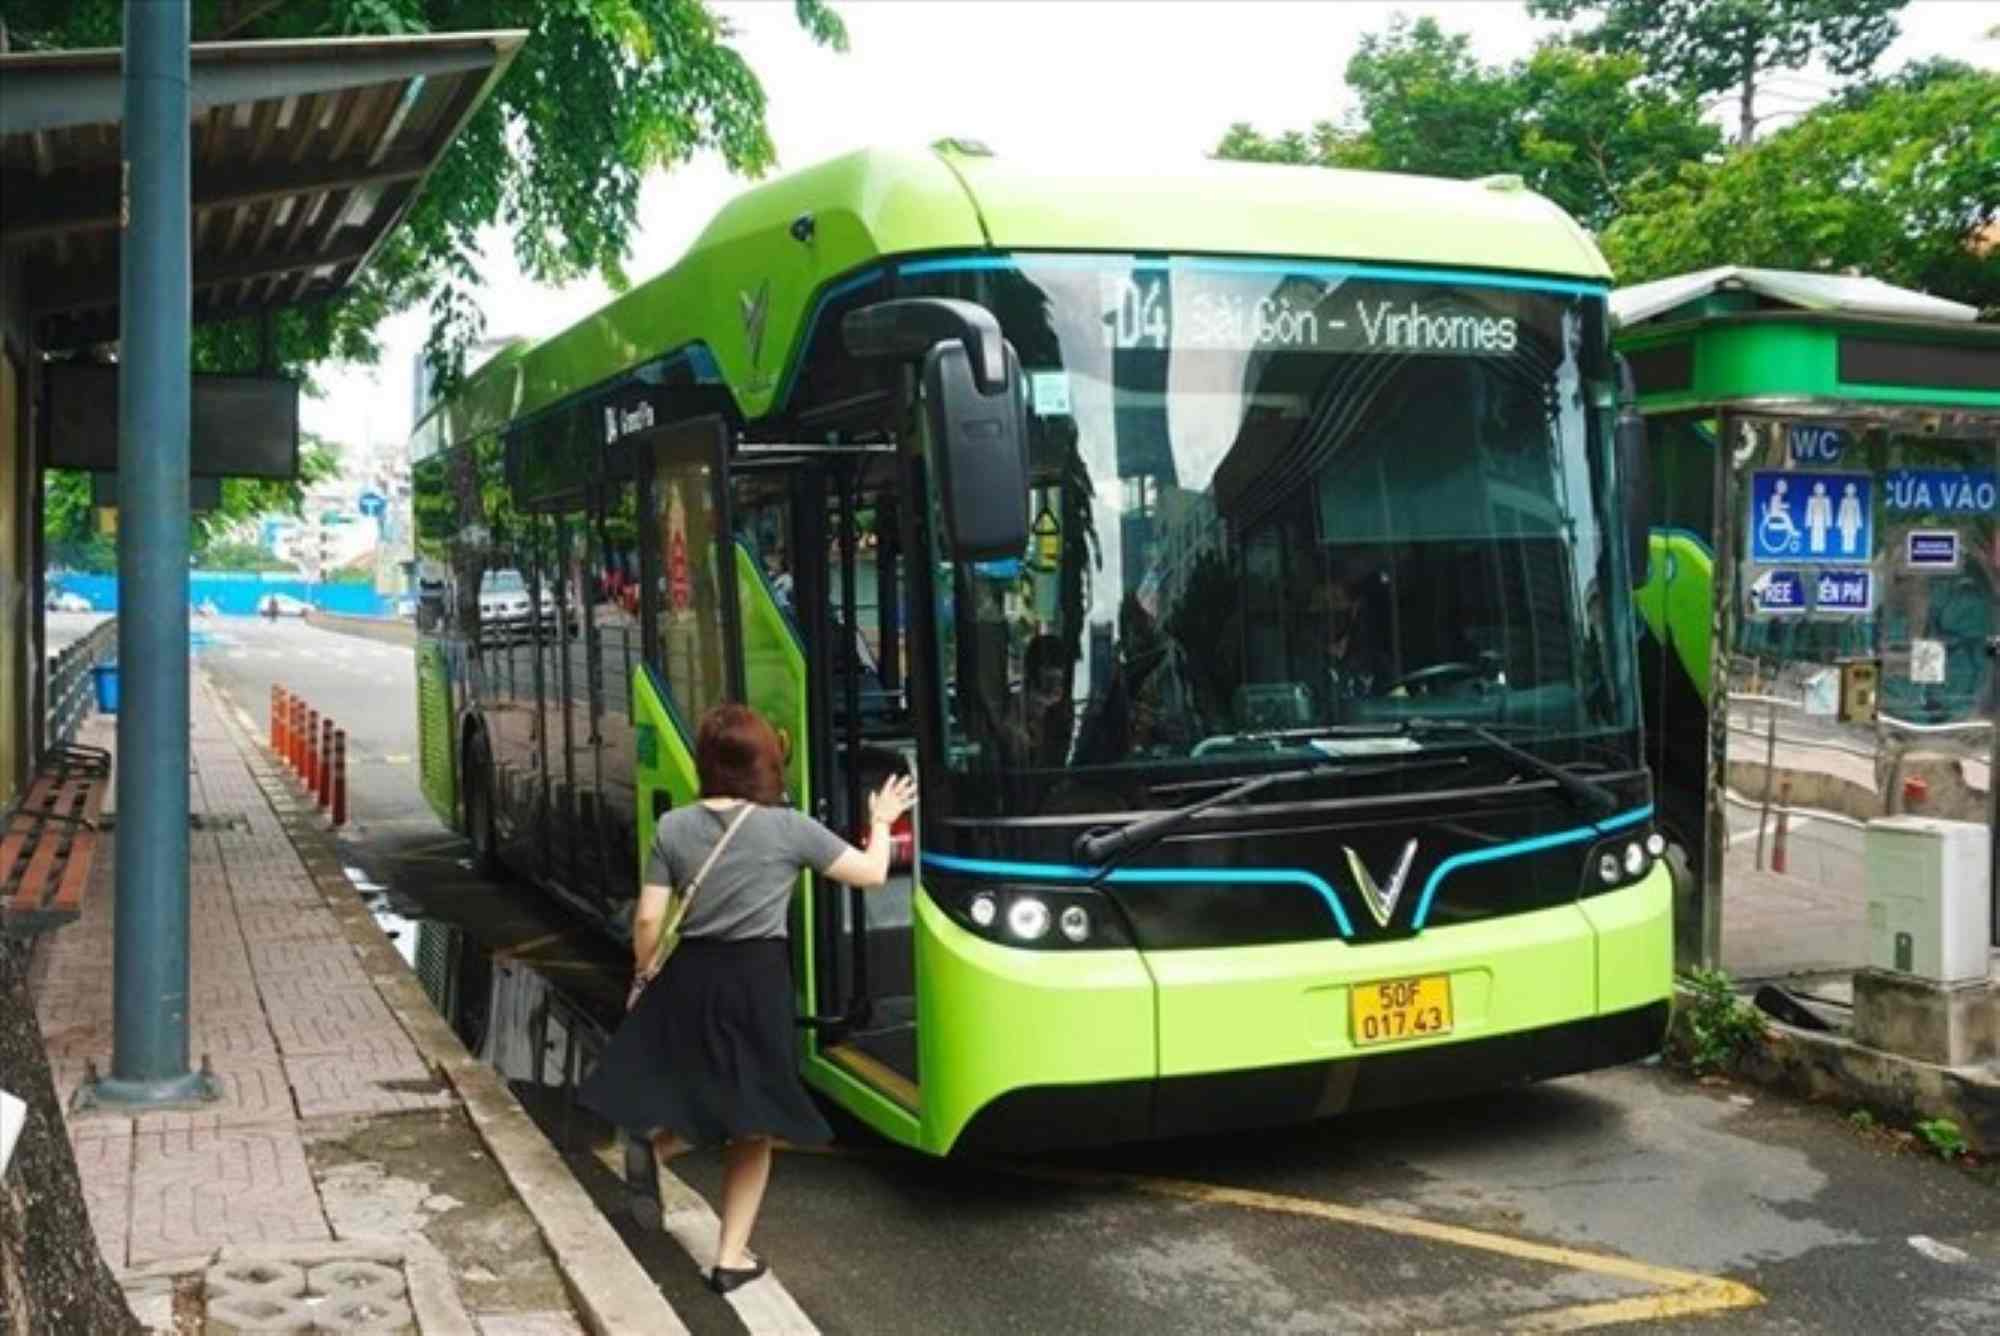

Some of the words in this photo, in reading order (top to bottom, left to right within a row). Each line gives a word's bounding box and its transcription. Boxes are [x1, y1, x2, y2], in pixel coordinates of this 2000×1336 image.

[1256, 296, 1318, 344] Gòn
[1356, 300, 1518, 351] Vinhomes
[1792, 431, 1839, 458] WC
[1940, 474, 1995, 510] VÀO
[1764, 583, 1793, 603] REE
[1379, 983, 1418, 1009] 50F
